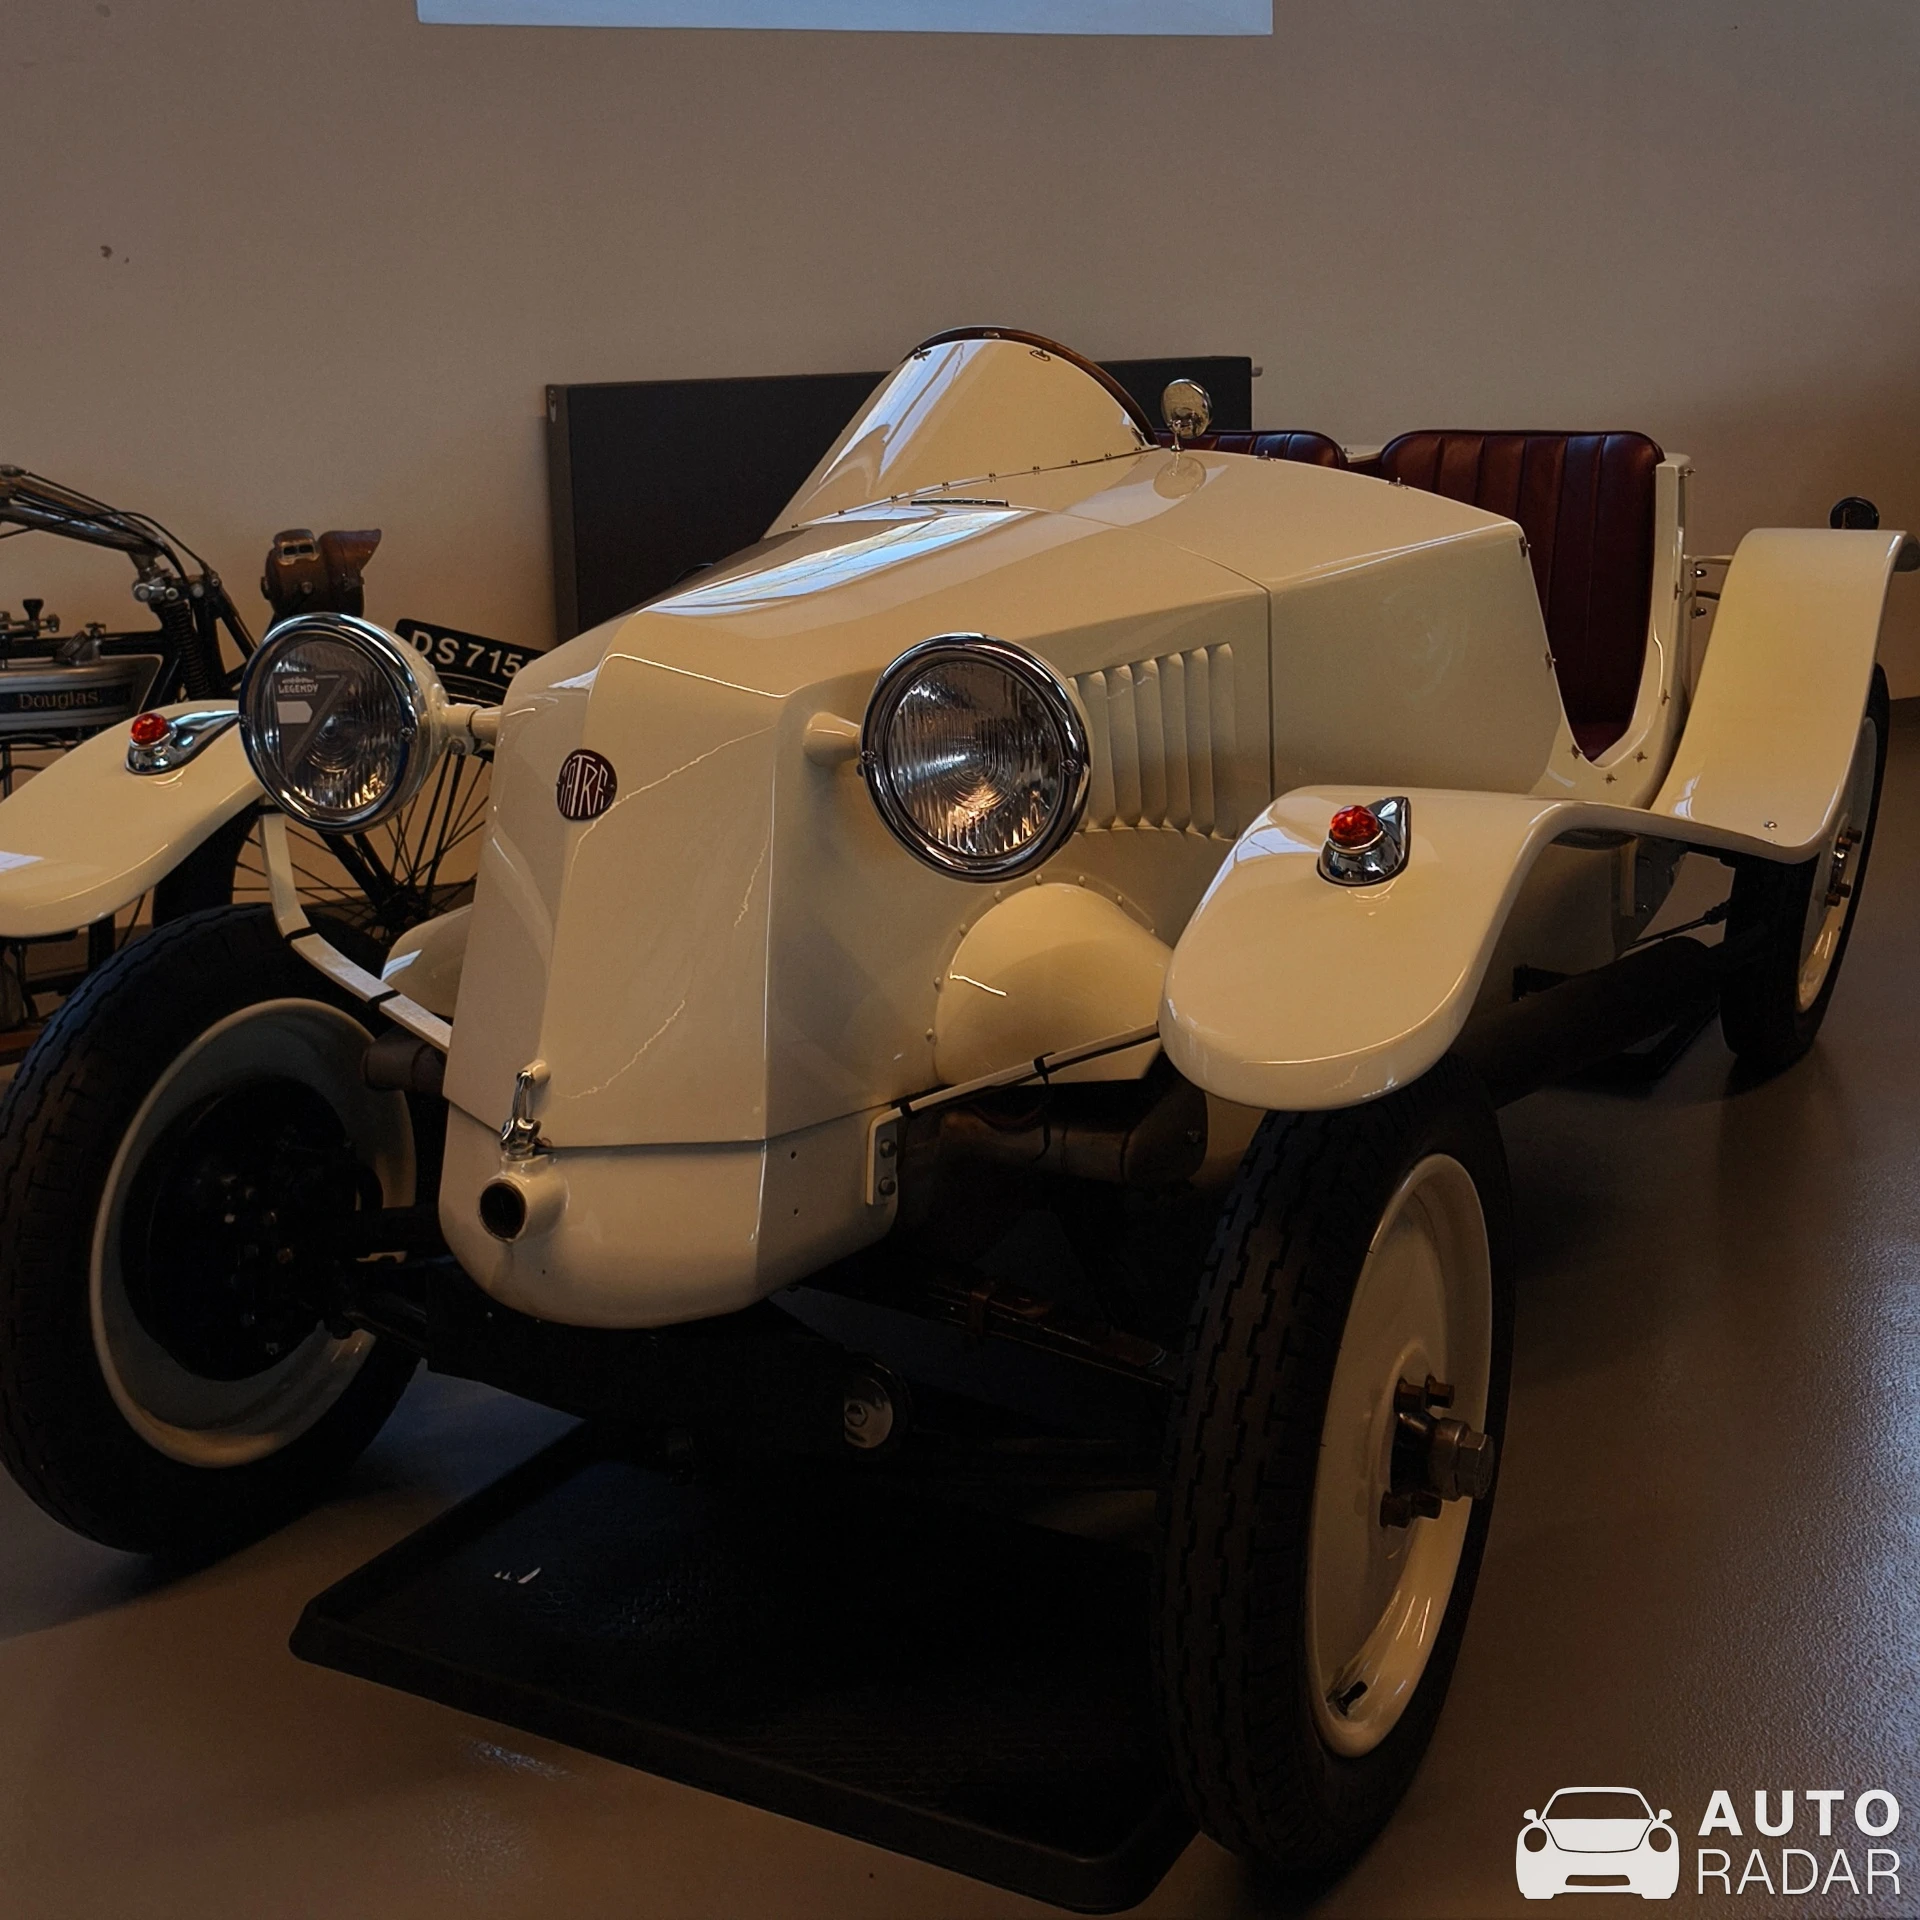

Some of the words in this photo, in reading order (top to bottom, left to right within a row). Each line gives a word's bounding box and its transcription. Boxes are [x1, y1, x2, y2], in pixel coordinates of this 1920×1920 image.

[465, 642, 538, 678] 715
[19, 691, 99, 709] Douglas
[278, 683, 319, 694] LEGENDY
[560, 754, 609, 817] TATRA
